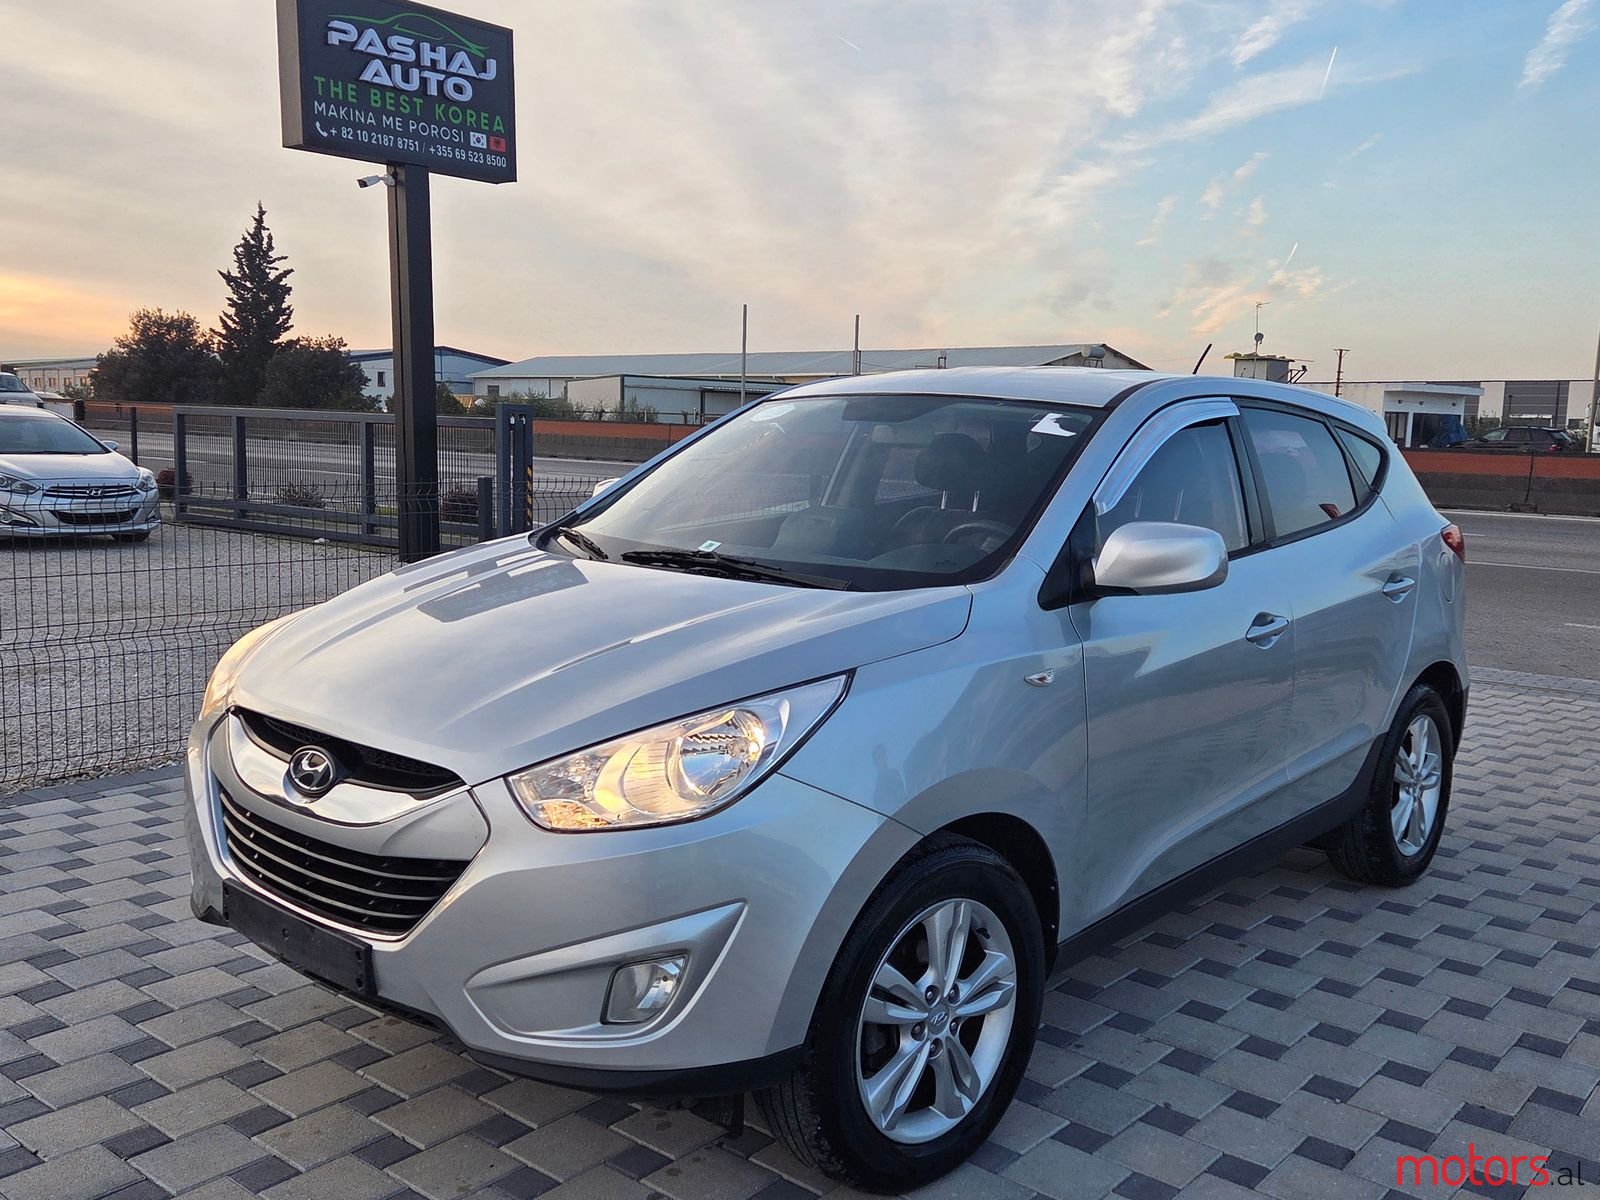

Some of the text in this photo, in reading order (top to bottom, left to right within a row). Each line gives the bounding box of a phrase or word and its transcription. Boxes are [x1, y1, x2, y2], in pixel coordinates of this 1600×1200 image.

[327, 20, 497, 81] PASHAJ
[359, 58, 473, 102] AUTO
[313, 75, 505, 133] THE BEST KOREA
[314, 100, 464, 143] MAKINA ME POROSI
[341, 126, 354, 140] 82
[356, 129, 369, 143] 10
[371, 132, 394, 147] 2187
[397, 137, 419, 152] 8751
[429, 144, 453, 158] +355
[455, 148, 466, 160] 69
[468, 150, 484, 164] 523
[486, 154, 507, 168] 8500
